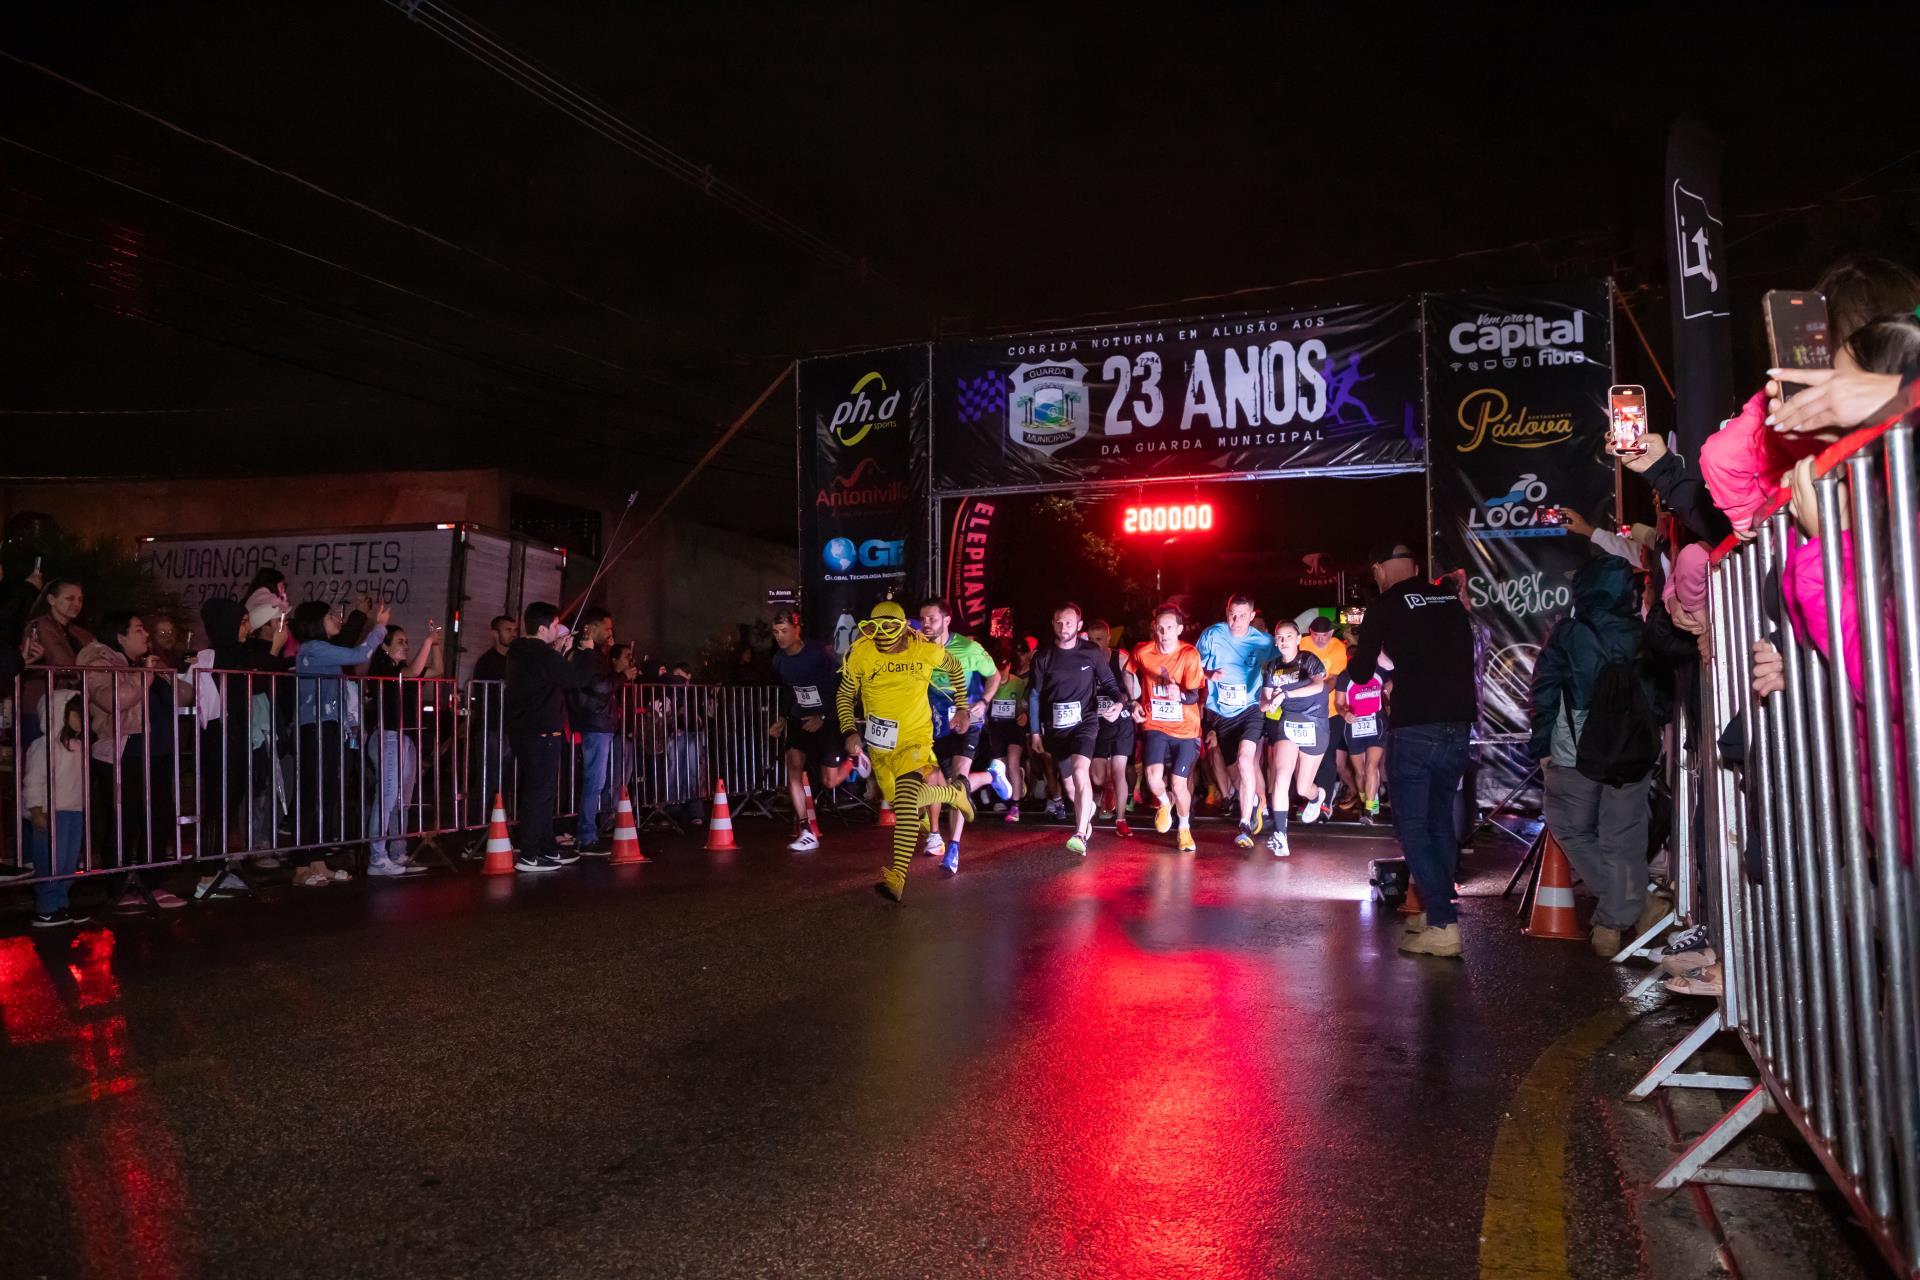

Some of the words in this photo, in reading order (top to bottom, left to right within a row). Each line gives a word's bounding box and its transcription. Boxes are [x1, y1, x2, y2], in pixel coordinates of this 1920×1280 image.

[1476, 313, 1500, 326] Vem
[1500, 313, 1526, 328] pra
[1008, 341, 1078, 356] CORRIDA
[1092, 332, 1165, 348] NOTURNA
[1178, 329, 1197, 340] EM
[1212, 321, 1278, 336] ALUSÃO
[1293, 317, 1325, 329] AOS
[1029, 367, 1067, 378] GUARDA
[1103, 351, 1164, 436] 23
[1180, 339, 1327, 430] ANOS
[829, 389, 901, 434] ph.d
[873, 420, 897, 430] sports
[1026, 431, 1071, 444] MUNICIPAL
[1101, 444, 1121, 455] DA
[1135, 439, 1203, 453] GUARDA
[1218, 430, 1324, 447] MUNICIPAL
[1123, 503, 1213, 533] 200000
[295, 541, 401, 576] FRETES
[1467, 571, 1544, 611] Super
[1226, 691, 1237, 699] 93
[1159, 705, 1175, 713] 422
[871, 723, 889, 738] 667
